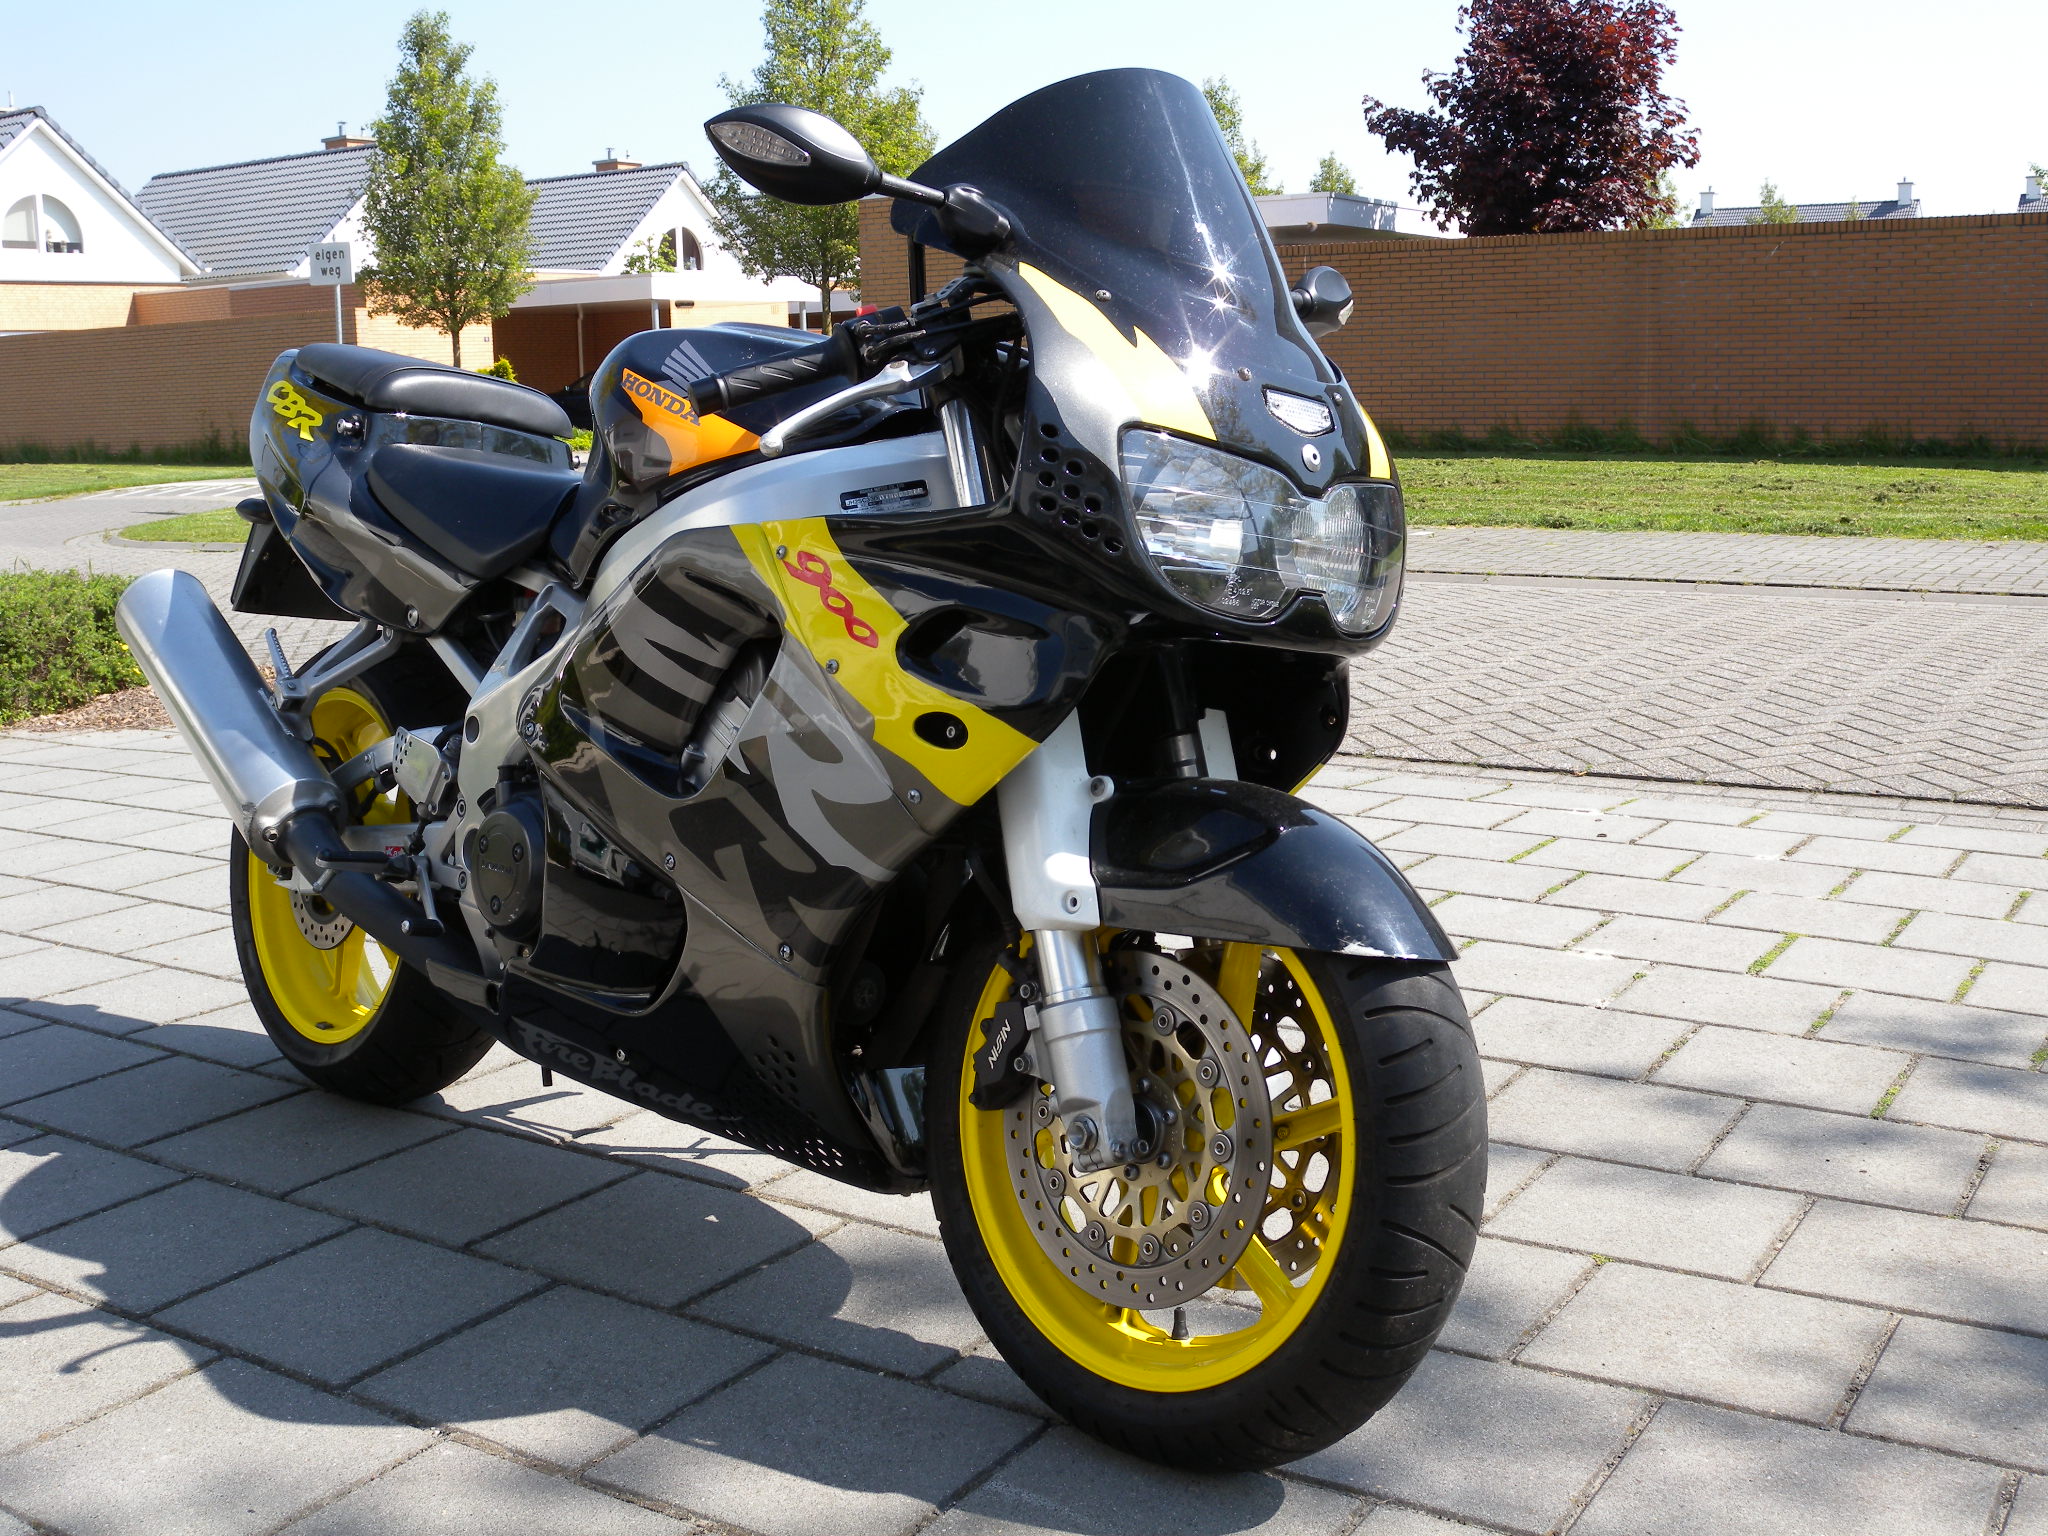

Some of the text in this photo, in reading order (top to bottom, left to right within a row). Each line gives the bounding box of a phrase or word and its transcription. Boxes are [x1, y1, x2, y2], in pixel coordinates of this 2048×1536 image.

[315, 249, 345, 263] eigen
[320, 266, 341, 279] weg
[266, 381, 323, 442] CBR
[621, 374, 700, 426] HONDA
[781, 551, 879, 649] 900
[988, 1018, 1011, 1070] NISSIN
